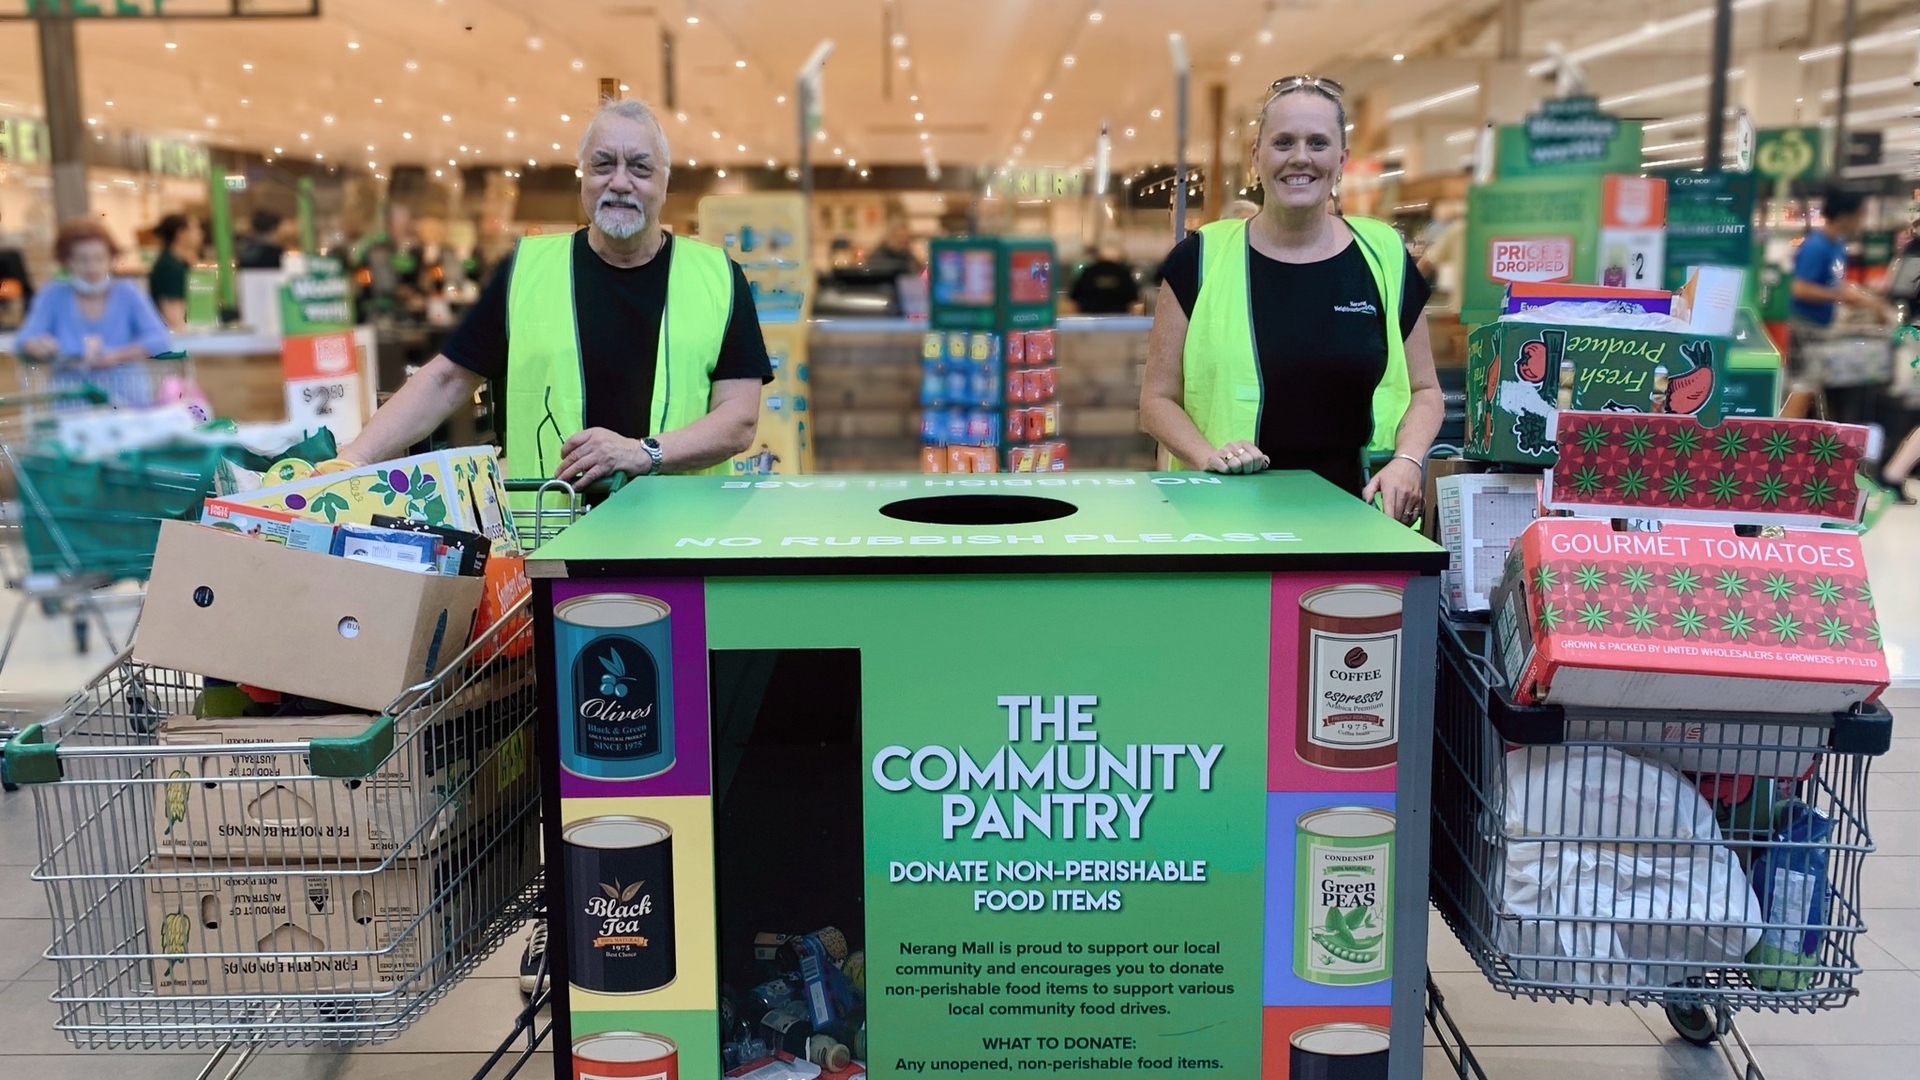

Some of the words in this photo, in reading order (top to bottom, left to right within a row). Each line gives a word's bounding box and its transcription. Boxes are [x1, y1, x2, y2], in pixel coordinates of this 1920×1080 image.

[1716, 224, 1746, 234] UNIT
[1496, 260, 1565, 272] DROPPED
[1566, 335, 1666, 364] Produce
[1579, 366, 1648, 393] Fresh
[1151, 476, 1222, 485] NO
[674, 536, 763, 548] NO
[780, 533, 1045, 547] RUBBISH
[1064, 531, 1303, 545] PLEASE
[1551, 533, 1691, 557] GOURMET
[1698, 537, 1855, 568] TOMATOES
[1560, 640, 1597, 650] GROWN
[1599, 641, 1606, 649] &
[1607, 642, 1647, 653] PACKED
[1649, 644, 1661, 655] BY
[1663, 645, 1700, 656] UNITED
[1700, 648, 1777, 661] WHOLESALERS
[1775, 653, 1783, 662] &
[1784, 653, 1835, 665] GROWERS
[1836, 657, 1858, 667] PTY.
[1859, 658, 1878, 668] LTD
[1329, 669, 1382, 682] COFFEE
[1324, 690, 1384, 705] espresso
[579, 698, 653, 722] Olives
[1326, 702, 1352, 712] Arabica
[1353, 702, 1384, 712] Premium
[998, 696, 1098, 741] THE
[1341, 723, 1368, 731] 1975
[587, 723, 611, 734] Black
[612, 726, 621, 735] &
[622, 724, 647, 734] Green
[625, 733, 647, 741] PRODUCT
[593, 741, 622, 751] SINCE
[624, 740, 643, 750] 1975
[872, 744, 1224, 792] COMMUNITY
[942, 793, 1153, 839] PANTRY
[326, 825, 350, 838] FAR
[1324, 854, 1374, 862] CONDENSED
[891, 861, 988, 882] DONATE
[996, 860, 1206, 882] NON-PERISHABLE
[1321, 879, 1376, 894] Green
[584, 894, 653, 918] Black
[975, 890, 1045, 911] FOOD
[1052, 890, 1121, 911] ITEMS
[1321, 892, 1376, 908] PEAS
[598, 918, 640, 937] Tea
[899, 942, 957, 957] Nerang
[962, 941, 994, 954] Mall
[999, 940, 1012, 954] is
[1016, 941, 1063, 957] proud
[1066, 942, 1084, 953] to
[1087, 942, 1149, 957] support
[1152, 943, 1180, 953] our
[1184, 941, 1220, 953] local
[334, 959, 358, 973] FAR
[895, 961, 983, 978] community
[986, 961, 1016, 974] and
[1020, 963, 1112, 978] encourages
[1115, 964, 1145, 978] you
[1148, 962, 1165, 974] to
[1169, 961, 1225, 974] donate
[885, 981, 1001, 998] non-perishable
[1005, 981, 1041, 994] food
[1046, 981, 1089, 994] items
[1092, 982, 1109, 994] to
[1113, 982, 1174, 998] support
[1177, 980, 1235, 994] various
[948, 1002, 984, 1015] local
[988, 1001, 1076, 1018] community
[1079, 1001, 1116, 1014] food
[1120, 1001, 1171, 1014] drives.
[981, 1037, 1032, 1049] WHAT
[1035, 1036, 1060, 1049] TO
[1064, 1036, 1137, 1049] DONATE:
[894, 1057, 926, 1073] Any
[930, 1057, 1013, 1073] unopened,
[1017, 1056, 1133, 1072] non-perishable
[1137, 1056, 1173, 1068] food
[1177, 1055, 1224, 1068] items.
